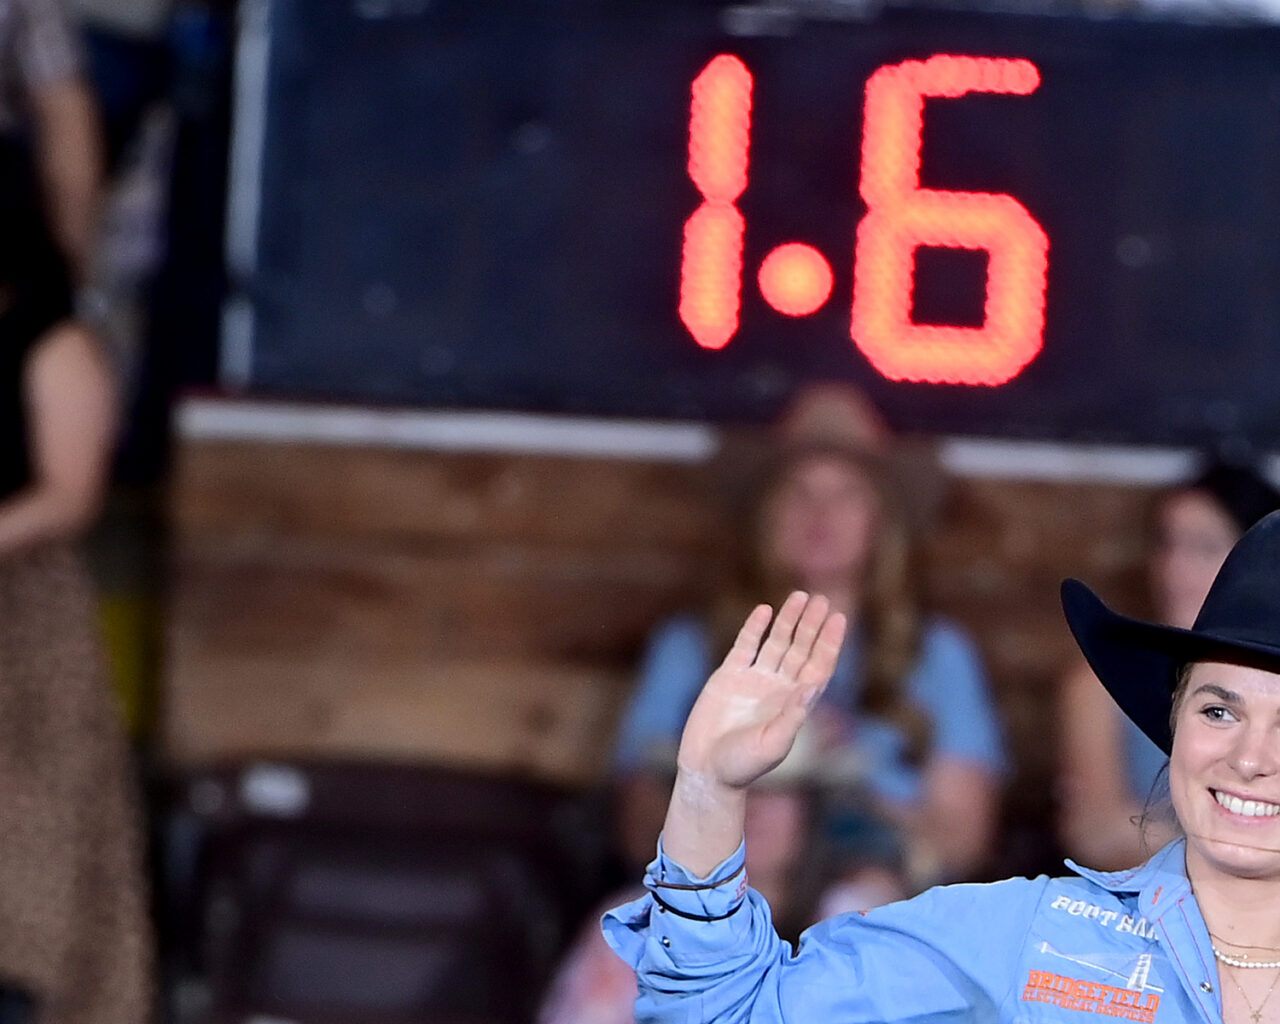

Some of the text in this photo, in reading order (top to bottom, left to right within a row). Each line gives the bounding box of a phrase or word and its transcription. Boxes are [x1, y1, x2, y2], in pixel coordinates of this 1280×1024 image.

[679, 53, 1050, 387] 1.6
[1050, 894, 1159, 940] BOOT BA
[1026, 969, 1161, 1013] BRIDGEFIELD
